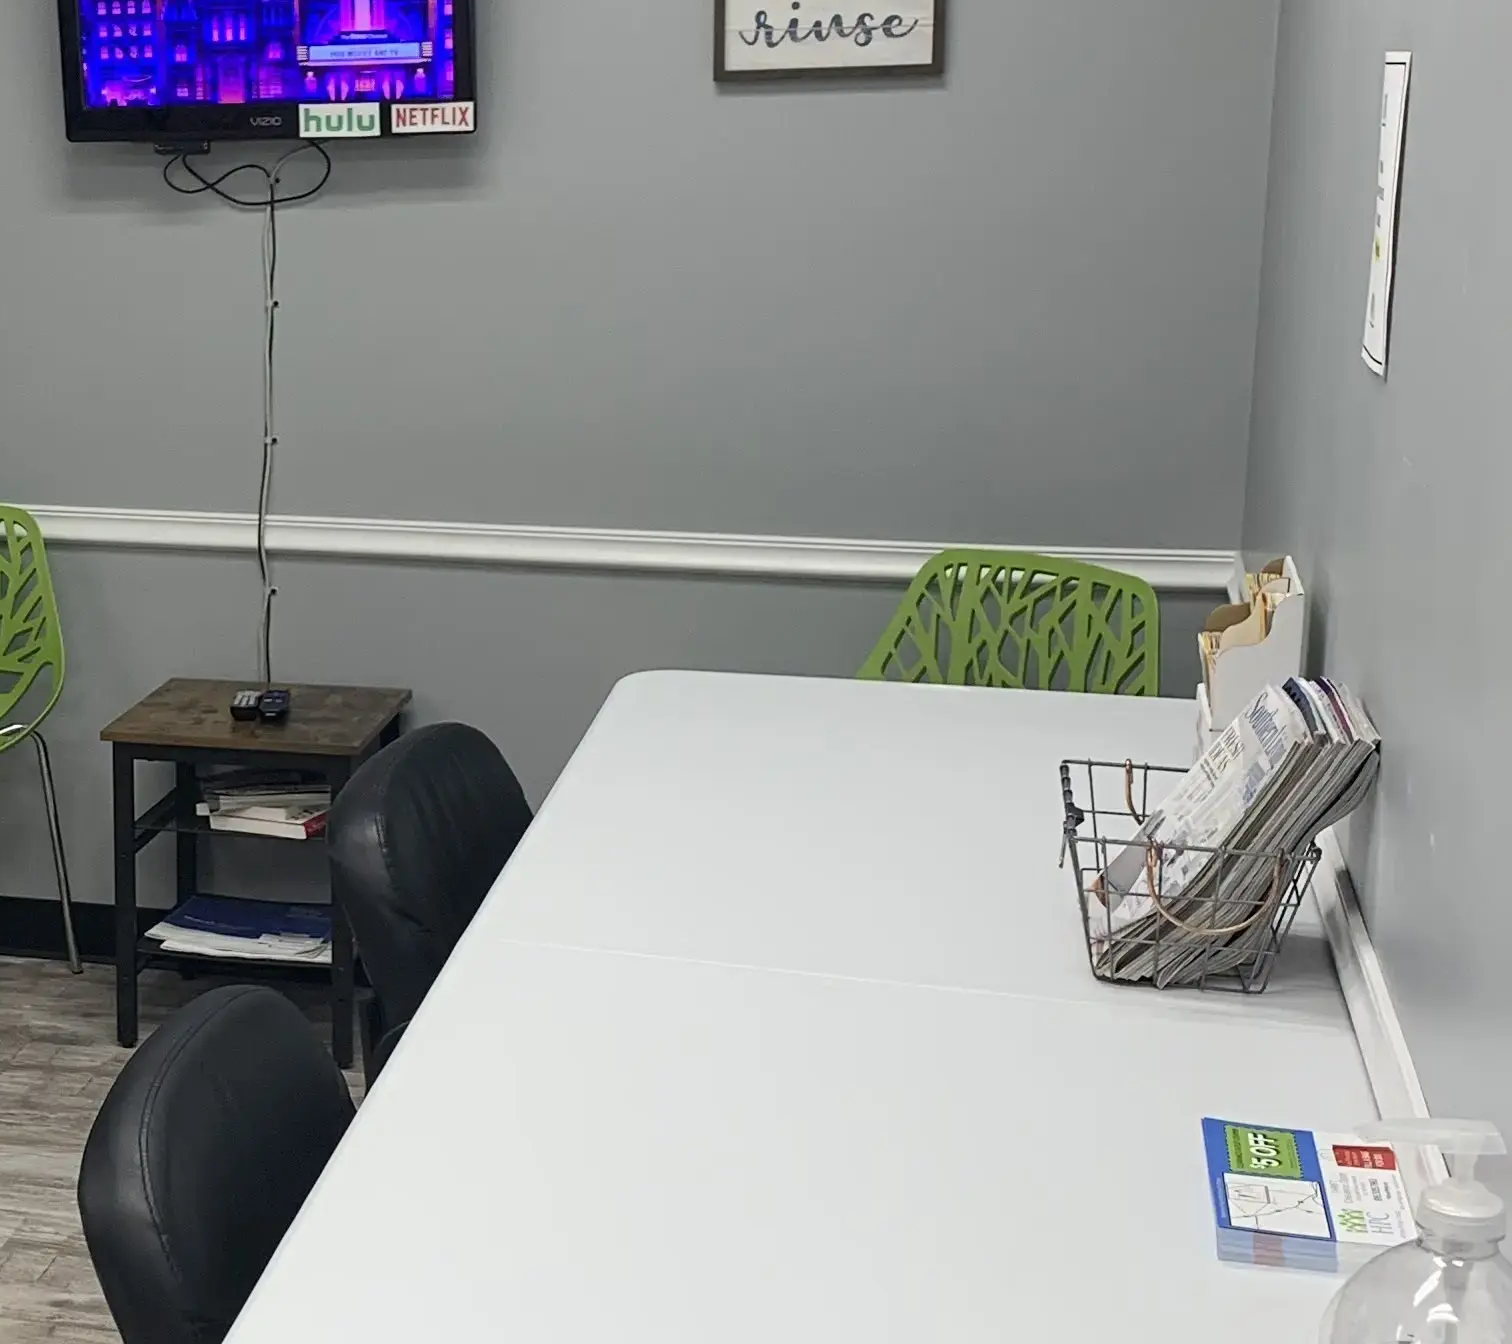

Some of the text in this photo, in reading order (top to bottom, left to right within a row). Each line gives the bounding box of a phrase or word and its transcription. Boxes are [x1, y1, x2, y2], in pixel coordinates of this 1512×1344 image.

[739, 1, 919, 48] rinse
[250, 115, 282, 128] VIZIO
[303, 108, 375, 133] hulu
[396, 106, 470, 128] NETFLIX
[1248, 1132, 1281, 1170] $5 OFF
